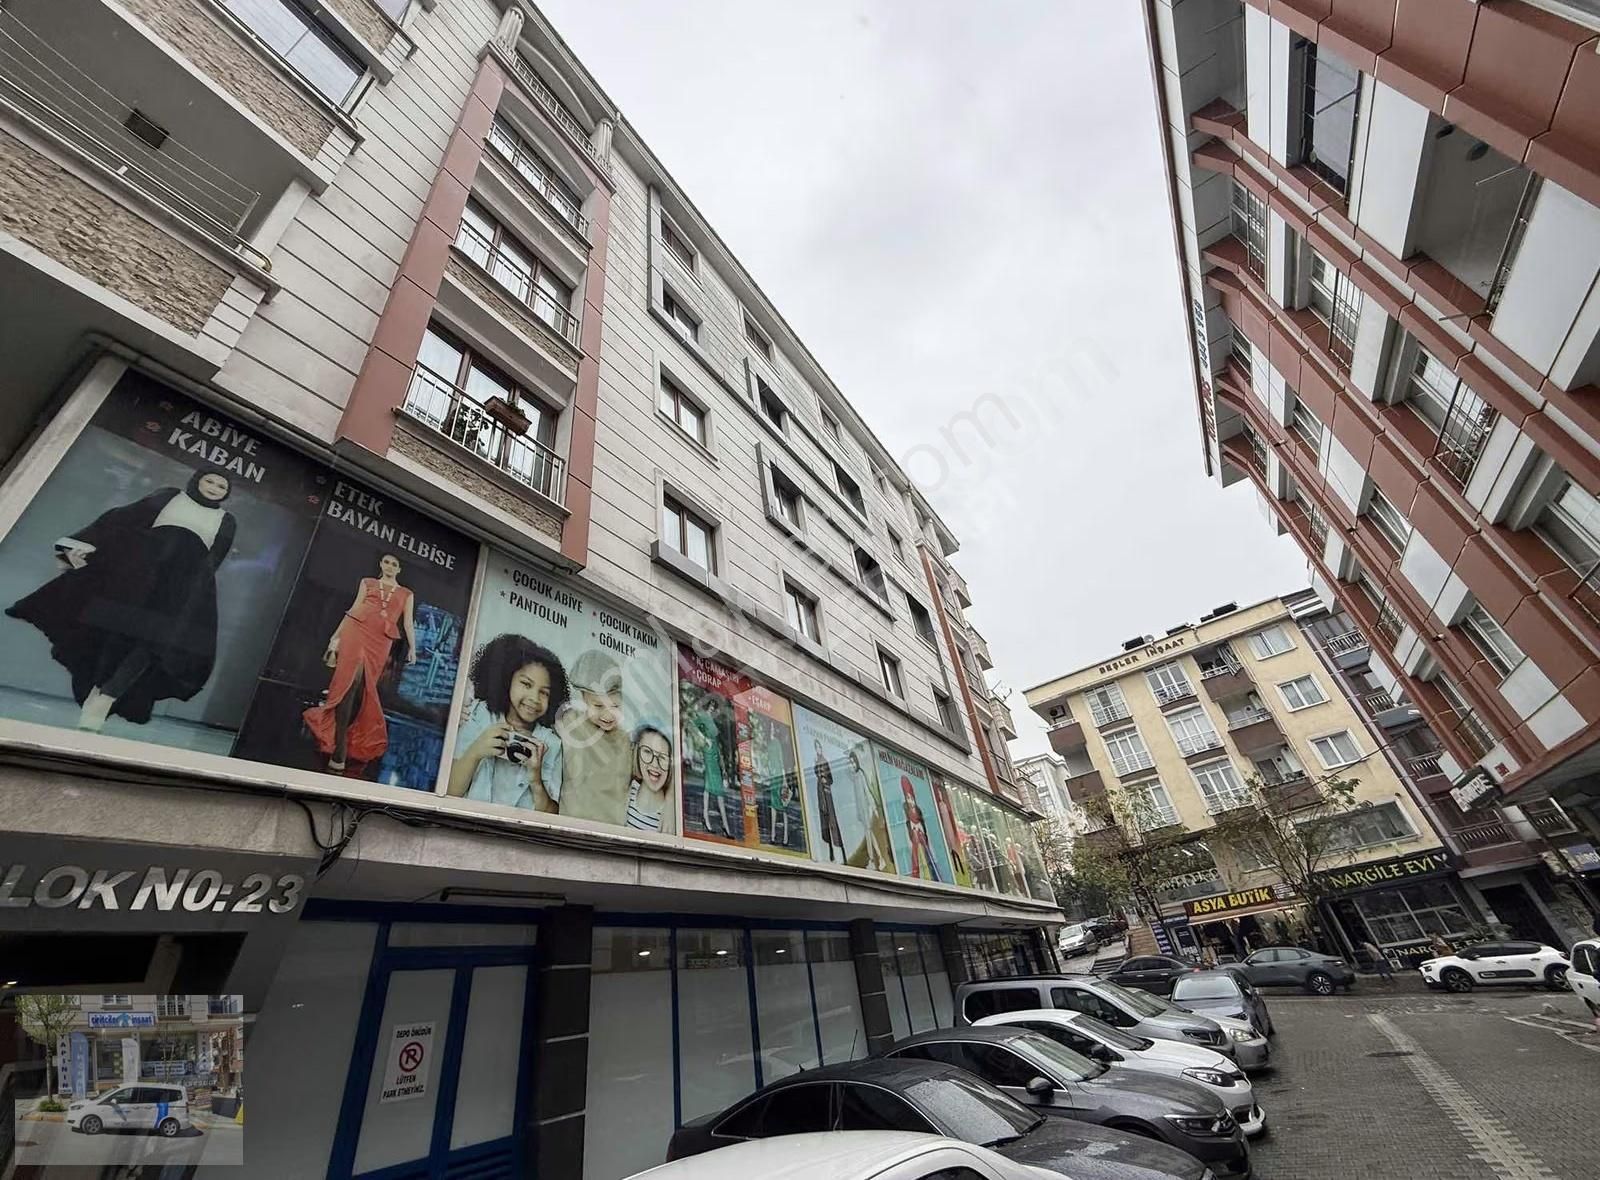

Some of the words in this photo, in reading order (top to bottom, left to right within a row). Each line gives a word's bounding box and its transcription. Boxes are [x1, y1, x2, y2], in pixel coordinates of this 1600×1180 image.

[180, 411, 262, 457] ABİYE
[167, 427, 266, 483] KABAN
[334, 481, 384, 516] ETEK
[326, 499, 396, 543] BAYAN
[397, 532, 456, 571] ELBİSE
[509, 591, 568, 629] PANTOLUN
[512, 569, 553, 599] ÇOCUK
[553, 590, 584, 614] ABİYE
[599, 632, 636, 658] GÖMLEK
[600, 611, 632, 636] ÇOCUK
[632, 626, 658, 649] TAKIM
[1099, 655, 1139, 674] BEŞLER
[1328, 863, 1404, 888] NARGİLE
[1193, 898, 1227, 914] ASYA
[1229, 888, 1271, 908] BUTİK
